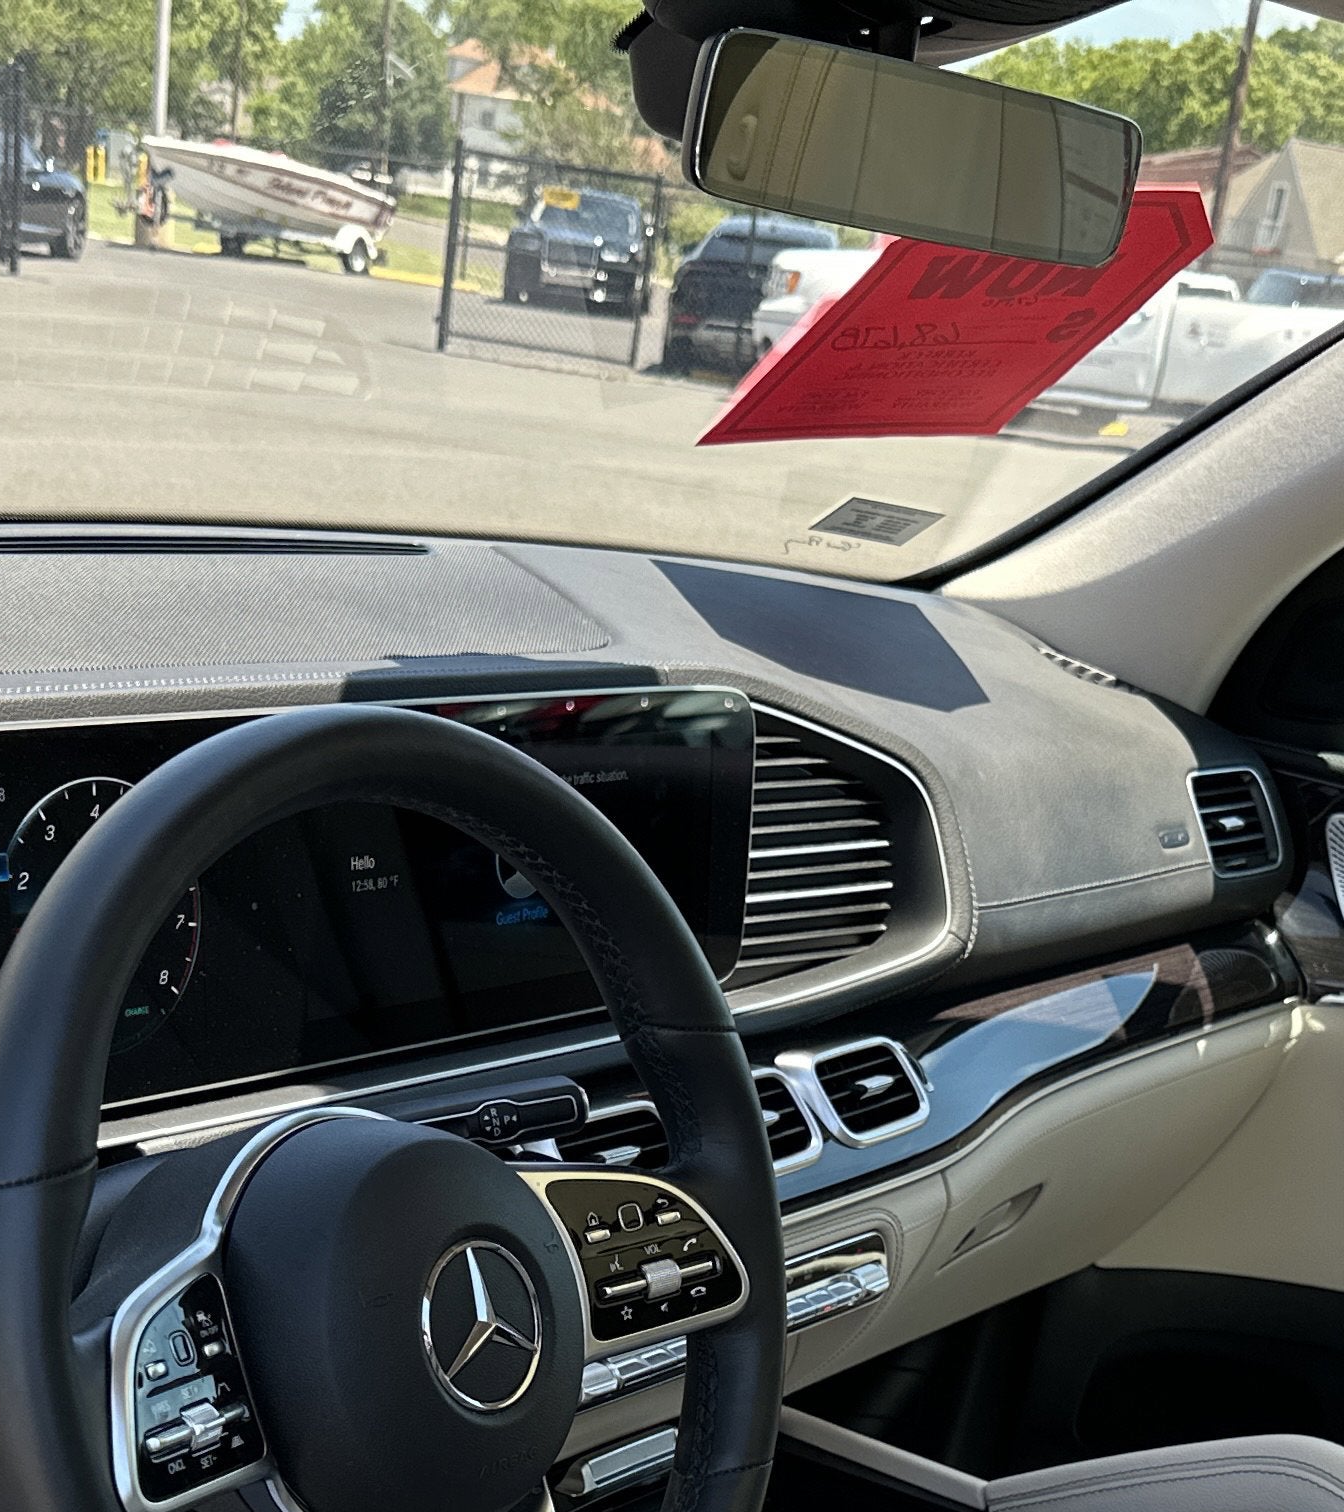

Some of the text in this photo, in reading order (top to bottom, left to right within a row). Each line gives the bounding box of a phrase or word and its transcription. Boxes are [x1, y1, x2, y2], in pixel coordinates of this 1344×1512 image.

[89, 804, 100, 819] 4
[44, 824, 56, 841] 3
[350, 855, 376, 871] Hello
[17, 871, 30, 891] 2
[175, 913, 185, 930] 7
[495, 905, 549, 926] Guest Profile
[158, 969, 169, 985] 8
[490, 1107, 498, 1117] R
[492, 1117, 501, 1127] N
[503, 1115, 511, 1125] P
[493, 1127, 502, 1136] D
[643, 1243, 661, 1255] VOL
